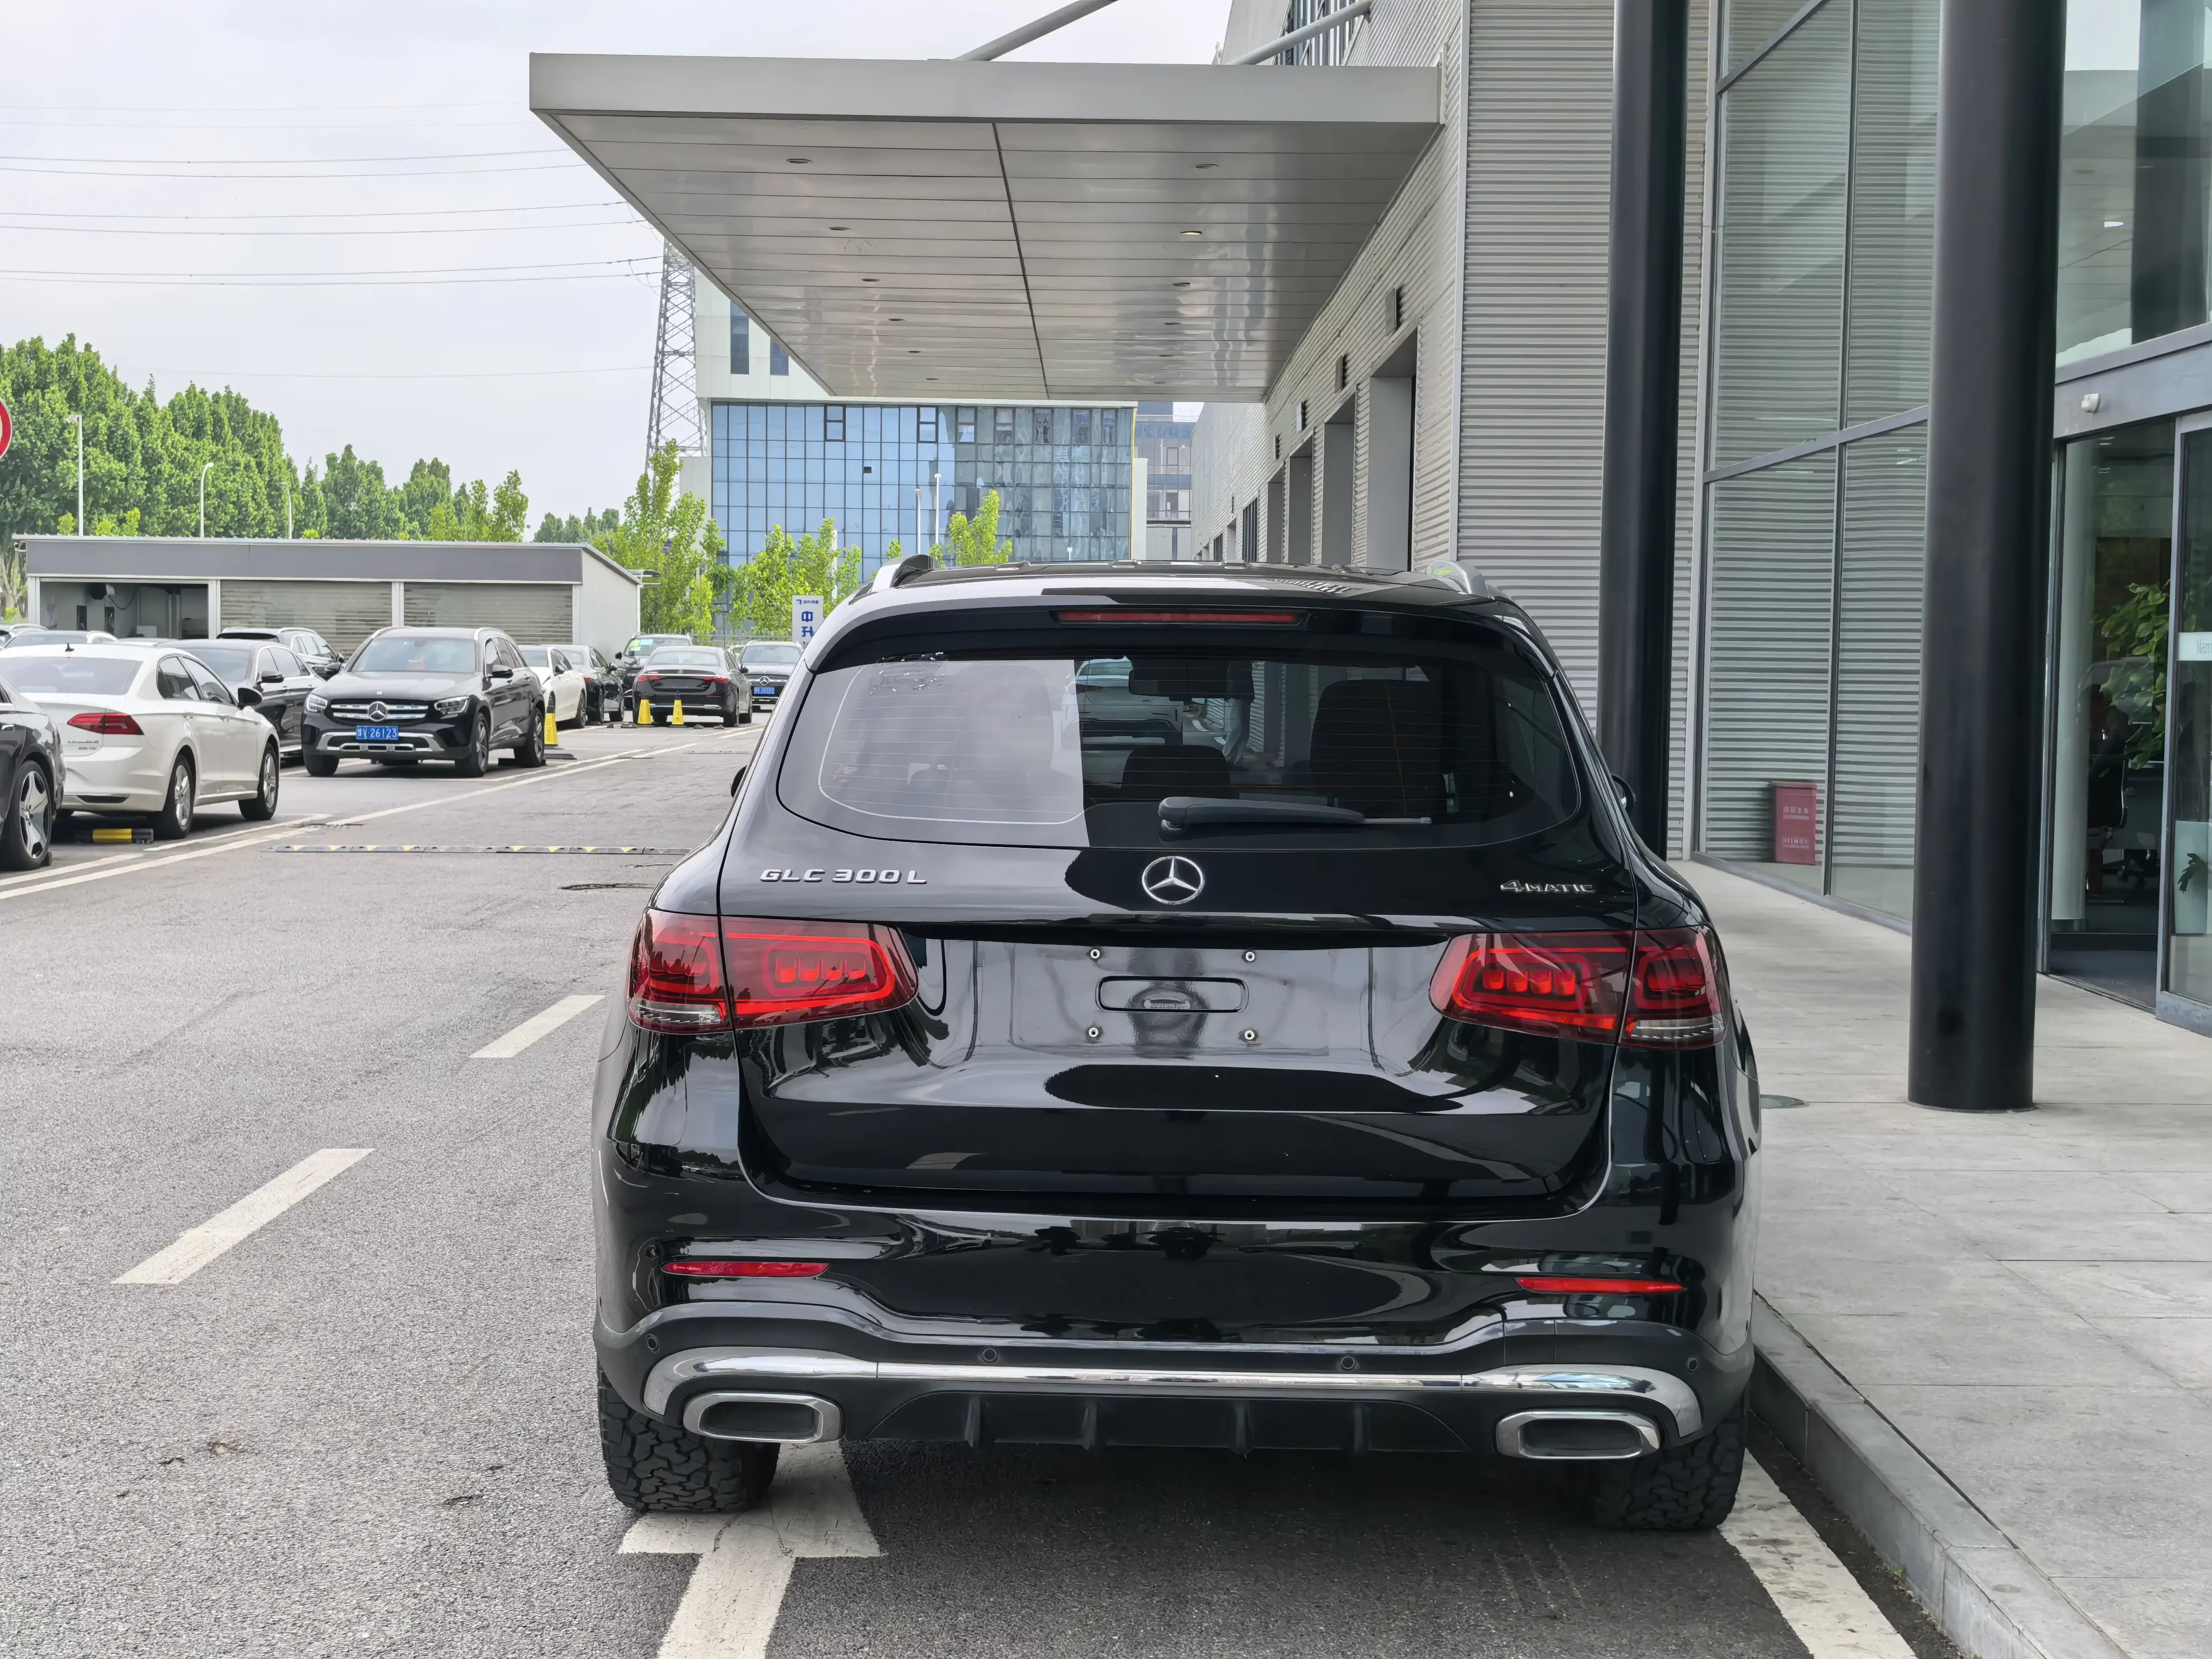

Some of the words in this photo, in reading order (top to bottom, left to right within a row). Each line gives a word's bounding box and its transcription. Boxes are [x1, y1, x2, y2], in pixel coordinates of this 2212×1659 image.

[801, 611, 814, 646] 中升
[760, 869, 825, 882] GLC
[1500, 880, 1595, 894] 4MATIC
